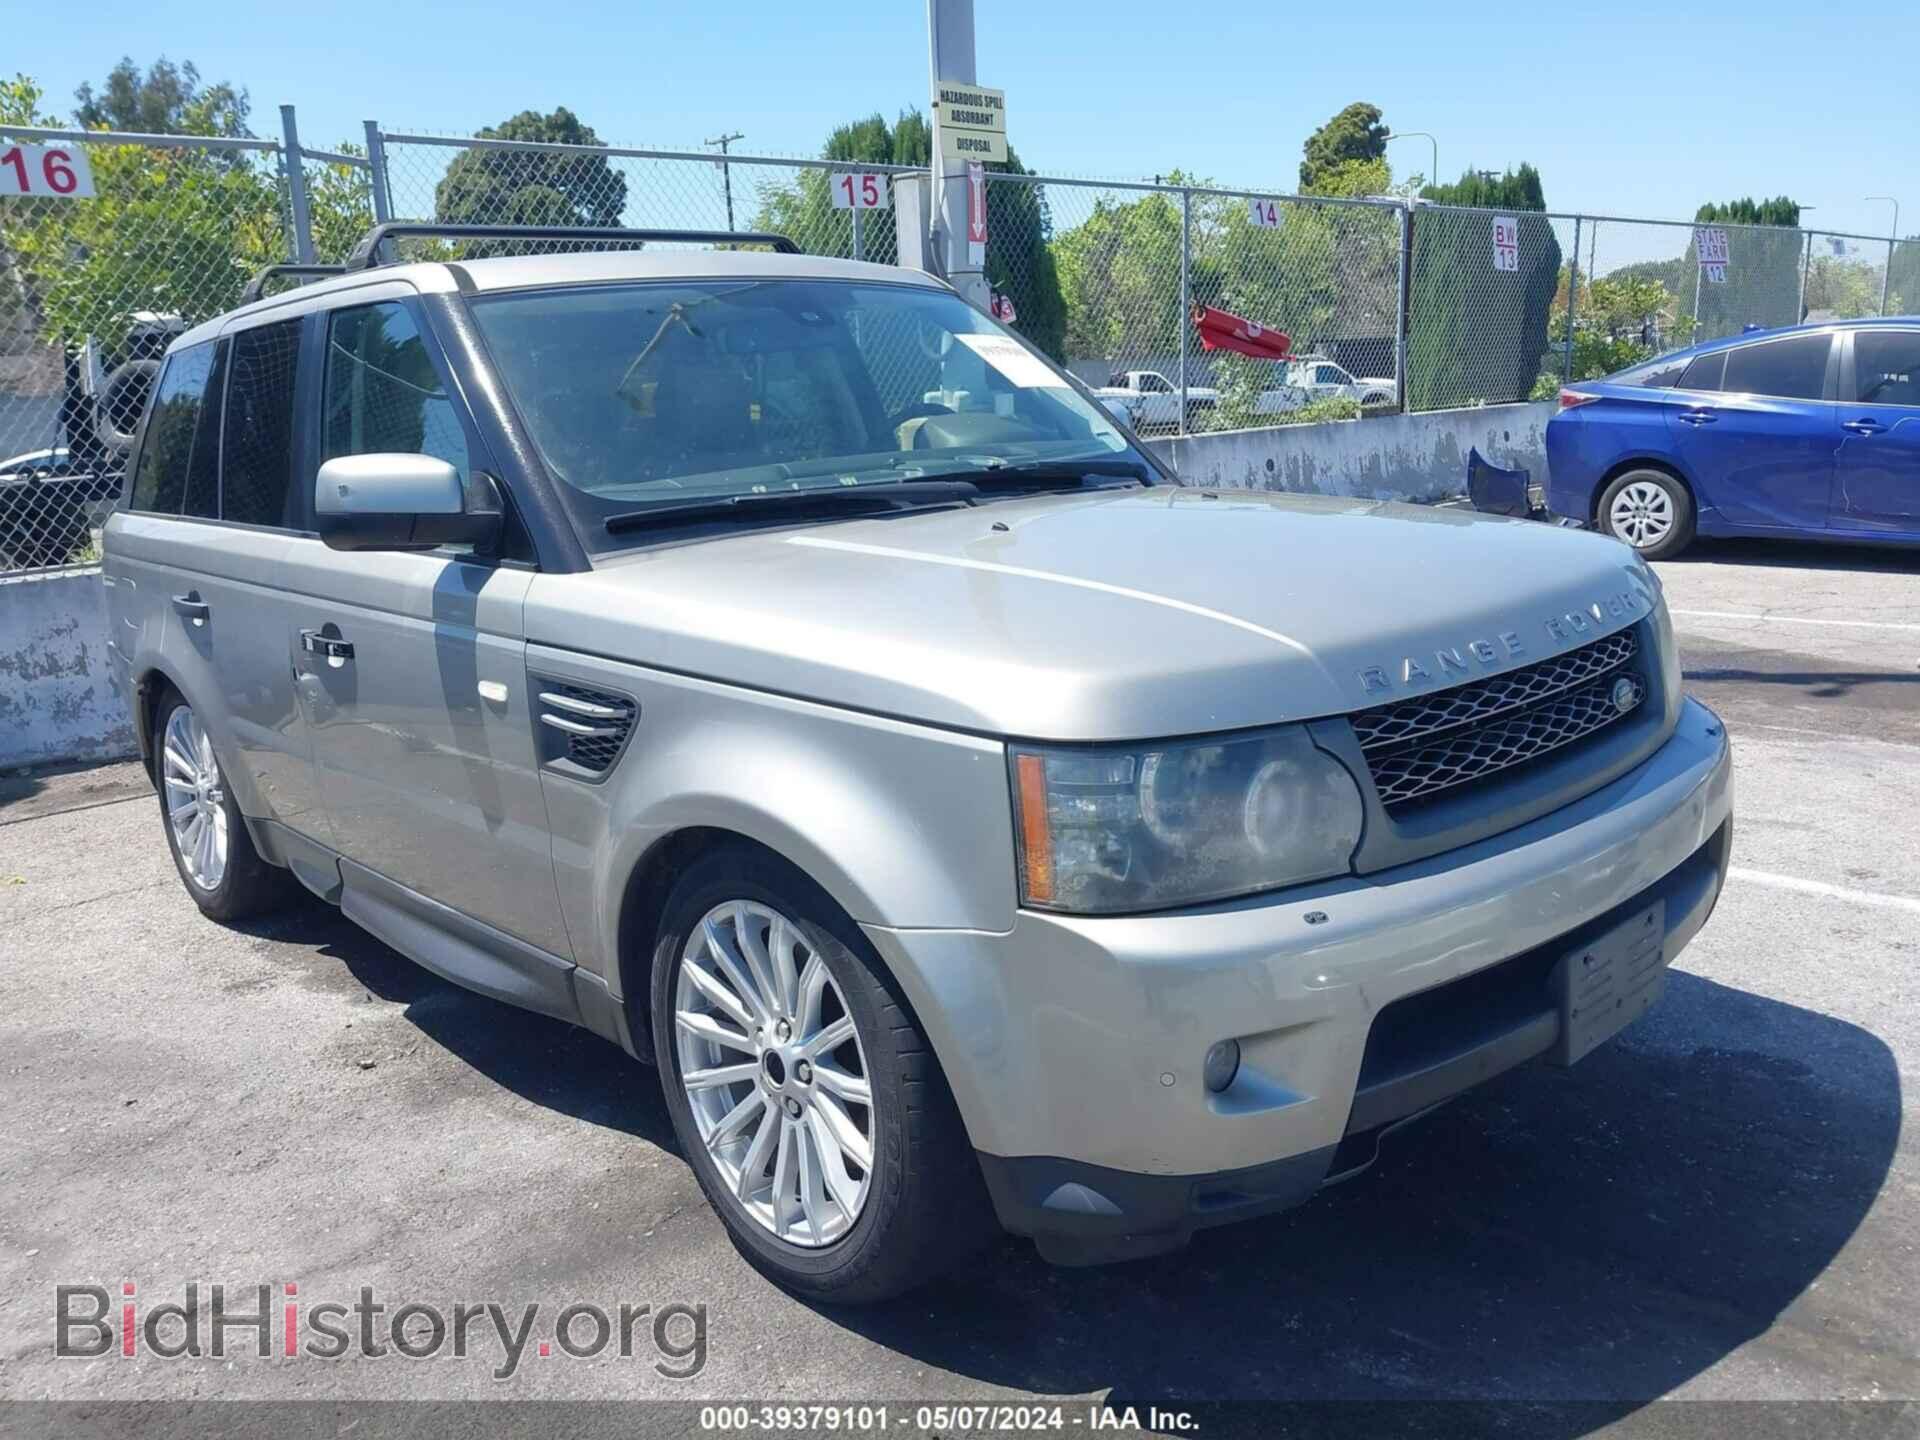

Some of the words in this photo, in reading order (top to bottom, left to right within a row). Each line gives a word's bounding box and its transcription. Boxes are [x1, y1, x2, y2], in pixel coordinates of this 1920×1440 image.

[940, 90, 983, 107] HAZARDOUS
[984, 95, 1004, 109] SPILL
[951, 110, 993, 126] ABSORBANT
[956, 137, 992, 153] DISPOSAL
[1, 147, 77, 194] 16
[841, 175, 879, 207] 15
[1255, 201, 1278, 226] 14
[1500, 249, 1516, 269] 13
[1356, 631, 1524, 692] RANGE
[1545, 590, 1643, 640] ROVER
